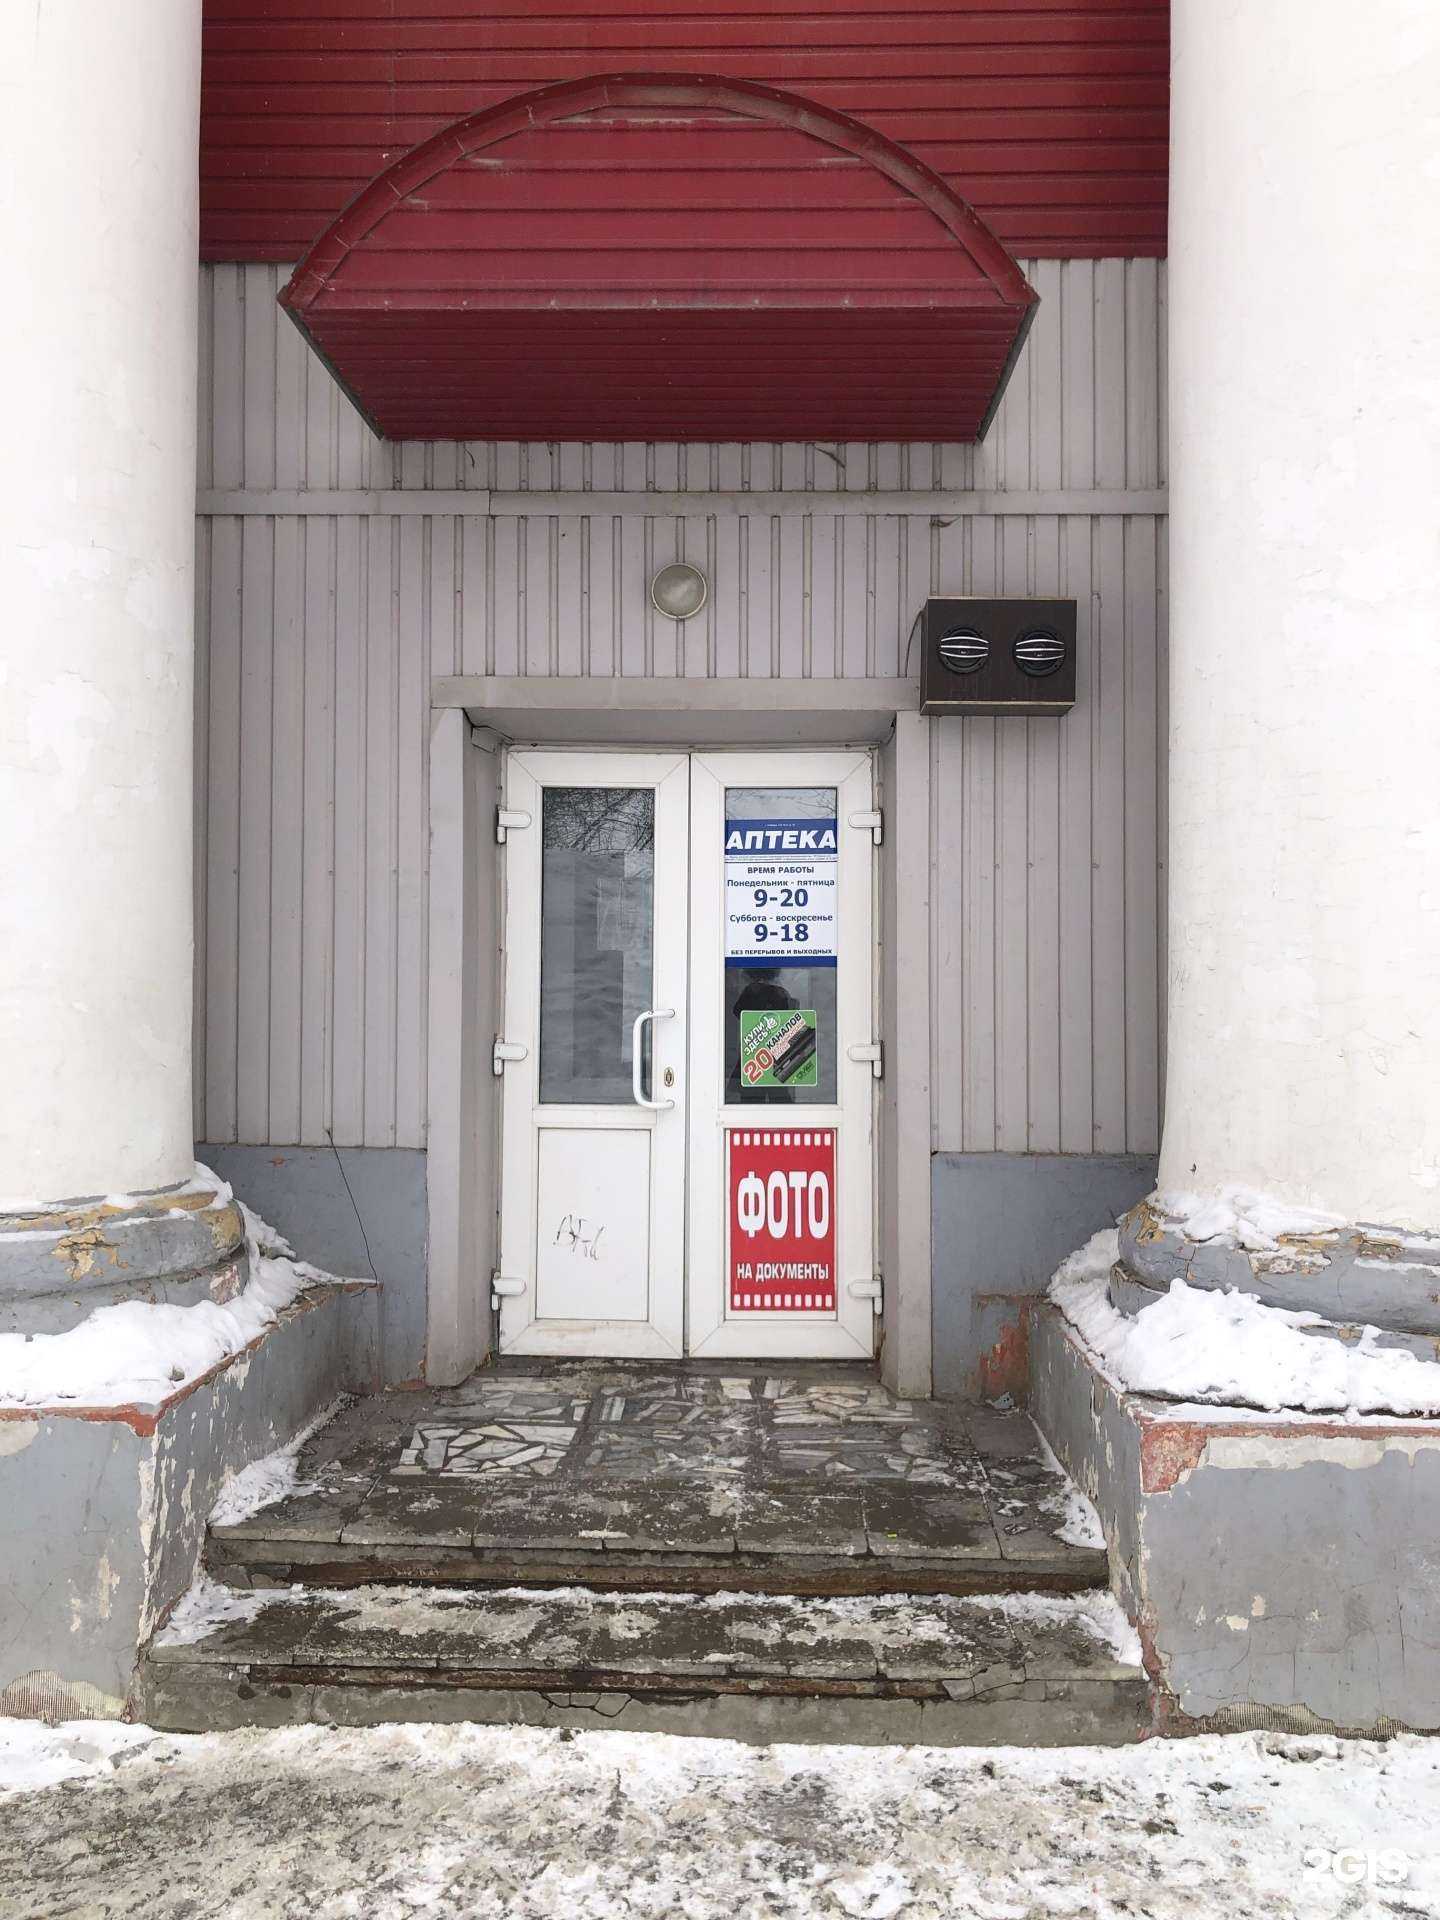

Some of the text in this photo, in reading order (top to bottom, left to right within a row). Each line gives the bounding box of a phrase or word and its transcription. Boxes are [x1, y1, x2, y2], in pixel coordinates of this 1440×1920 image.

[725, 830, 837, 849] АПТЕКА
[754, 889, 809, 908] 9-20
[729, 915, 767, 924] Суббота
[776, 915, 833, 923] воскресенье
[754, 924, 809, 943] 9-18
[744, 1022, 765, 1044] КУПИ
[743, 1048, 773, 1084] 20
[767, 1012, 802, 1049] КАНАЛОВ
[737, 1171, 830, 1239] ФОТО
[737, 1263, 829, 1282] НА ДОКУМЕНТЫ
